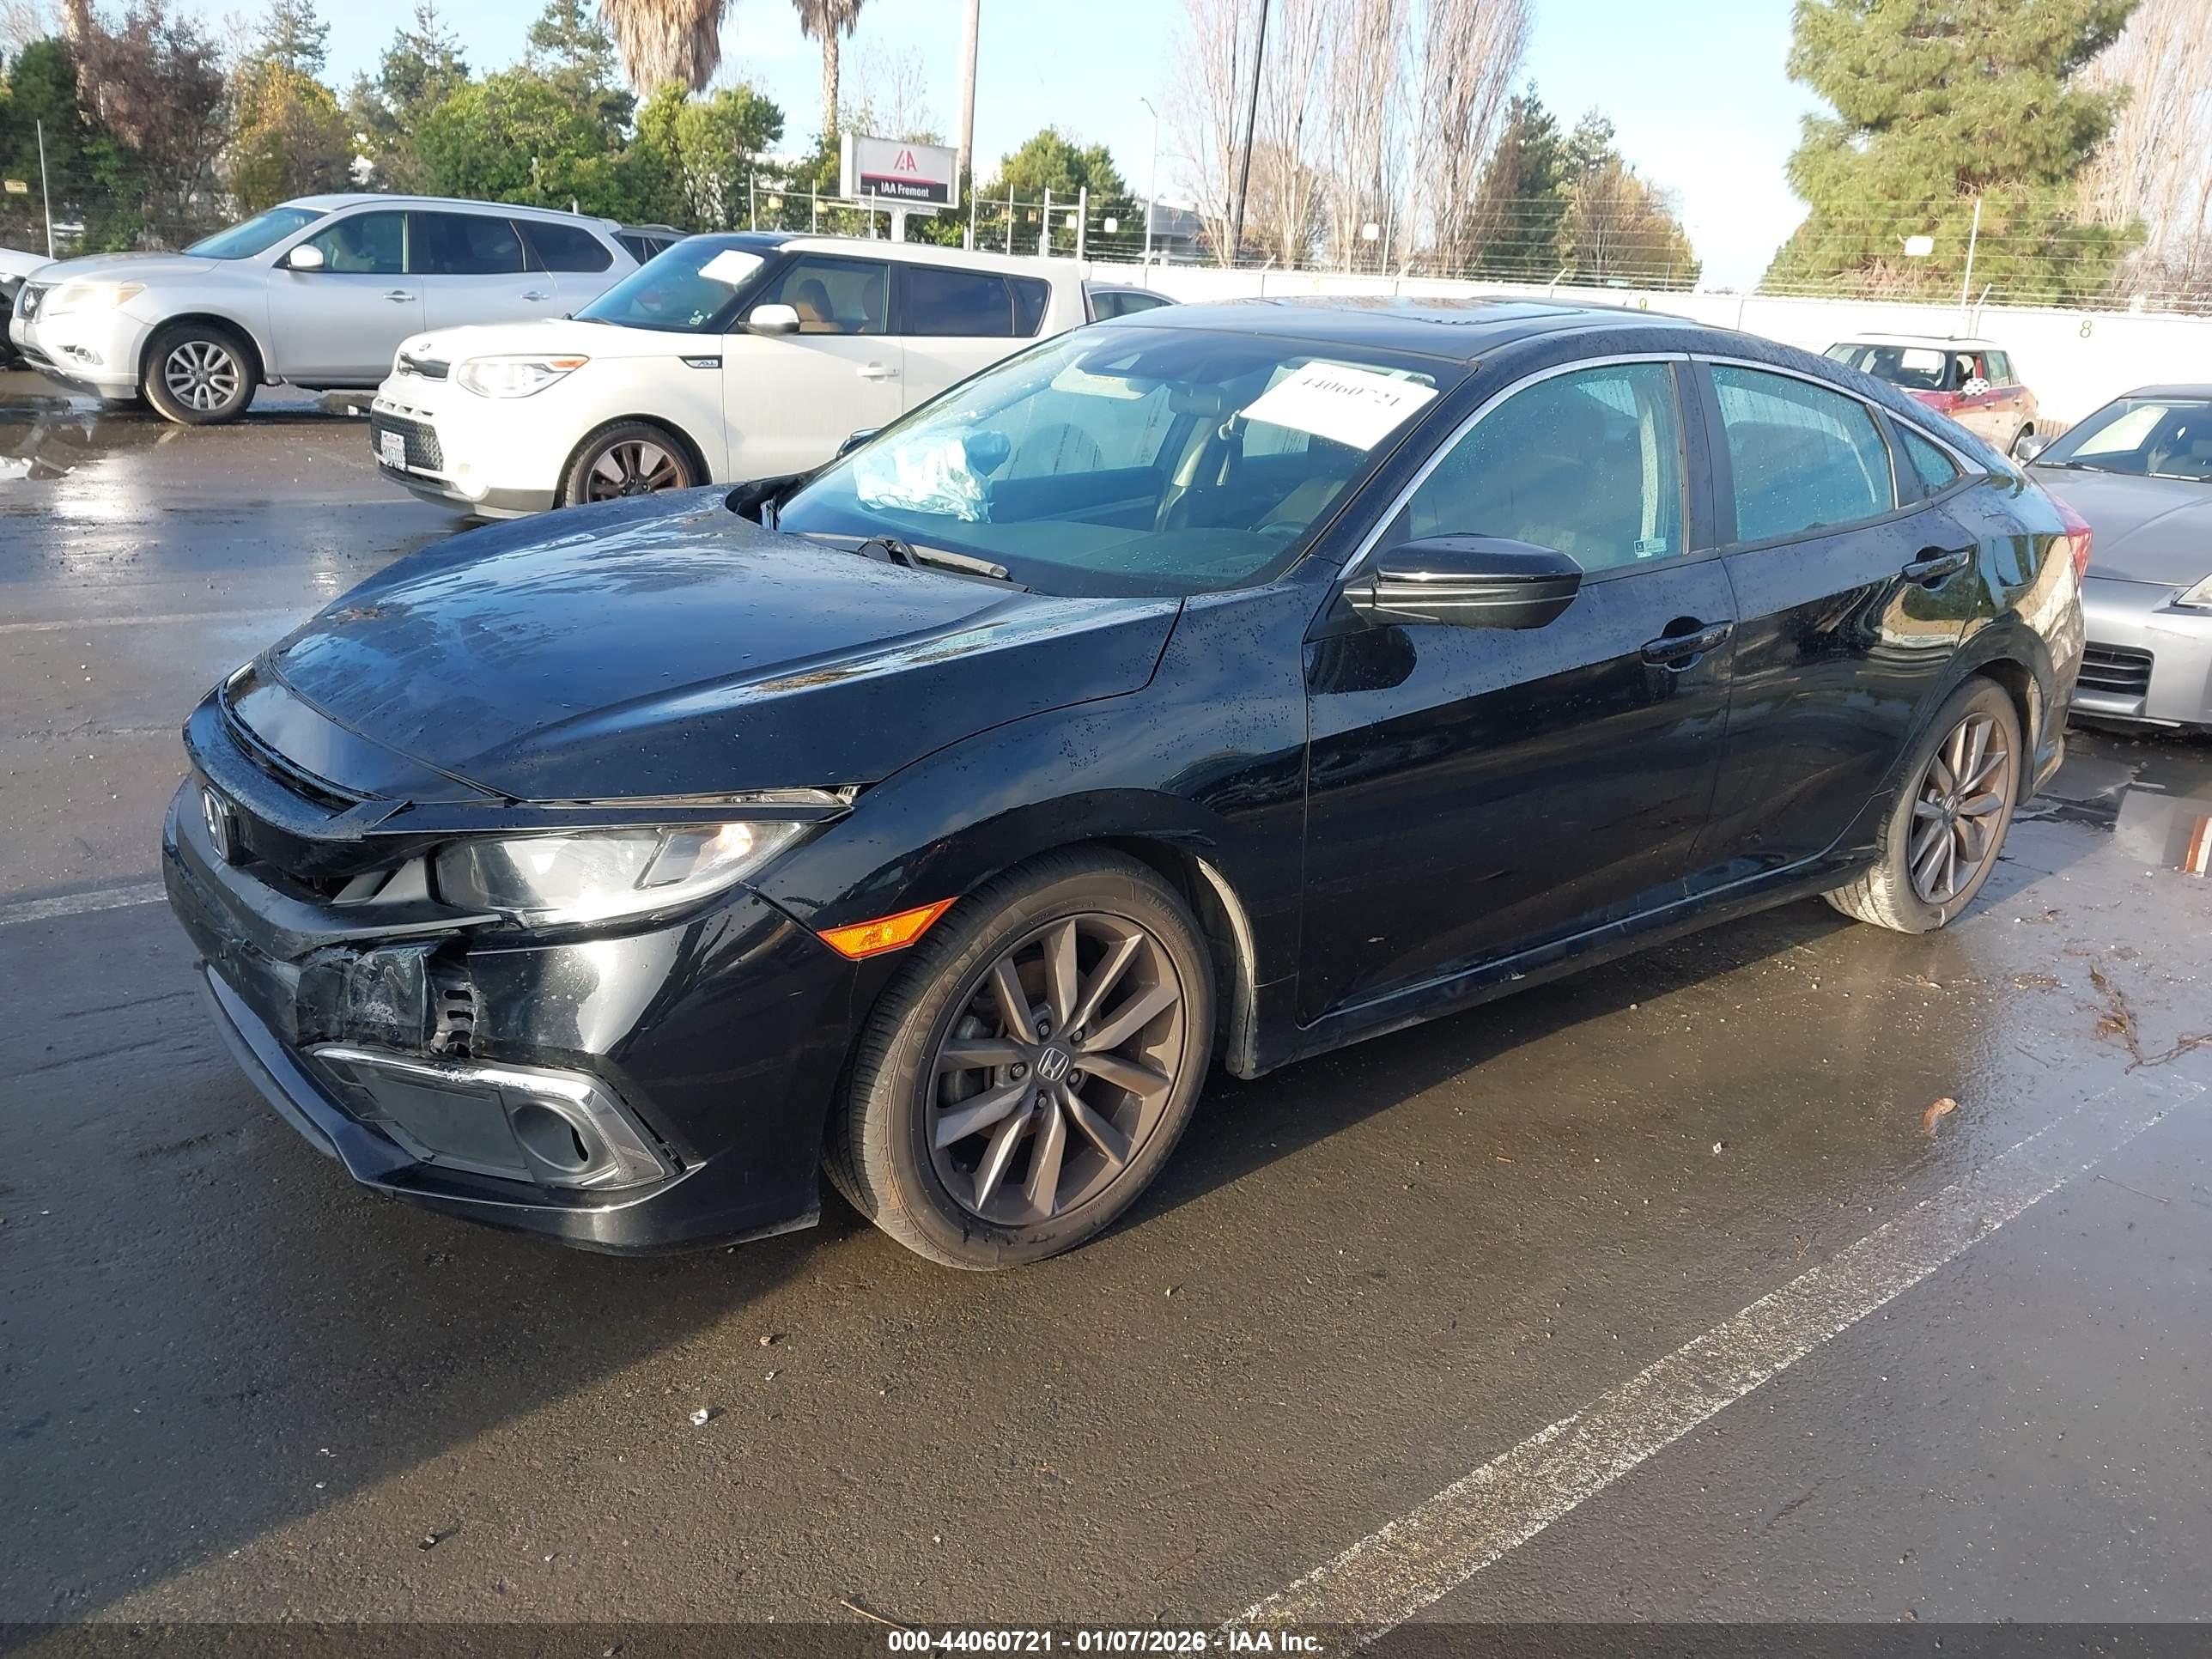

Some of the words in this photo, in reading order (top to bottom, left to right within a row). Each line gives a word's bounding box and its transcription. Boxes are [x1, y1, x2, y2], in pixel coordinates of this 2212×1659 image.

[880, 181, 896, 195] IAA
[898, 184, 930, 198] Fremont
[2080, 319, 2093, 338] 8
[1302, 378, 1401, 407] 440601
